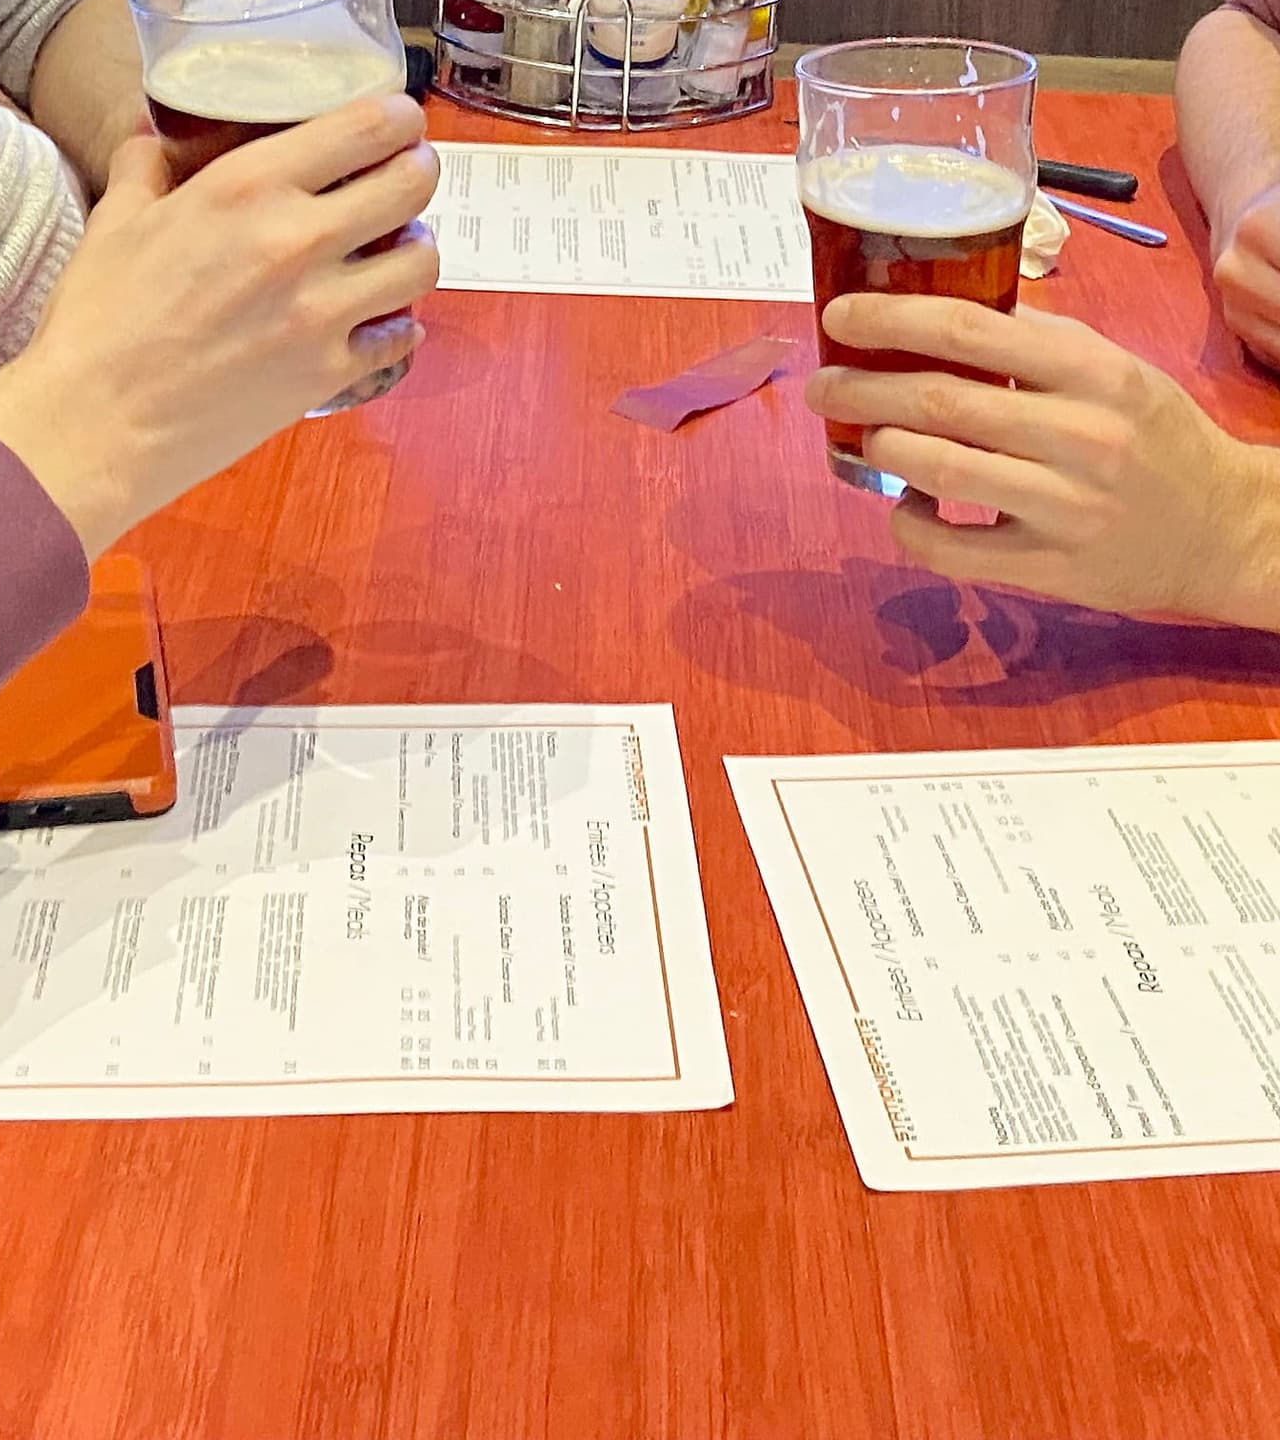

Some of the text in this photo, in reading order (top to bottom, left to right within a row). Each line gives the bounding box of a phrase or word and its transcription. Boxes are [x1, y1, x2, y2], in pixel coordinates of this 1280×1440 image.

[345, 834, 373, 880] Repas
[587, 821, 609, 866] Entrées
[347, 896, 371, 939] Meals
[590, 881, 617, 955] Appetizers
[854, 881, 892, 952] Appetizers
[1091, 885, 1126, 927] Meals
[1124, 942, 1162, 992] Repas
[888, 968, 922, 1021] Entrées
